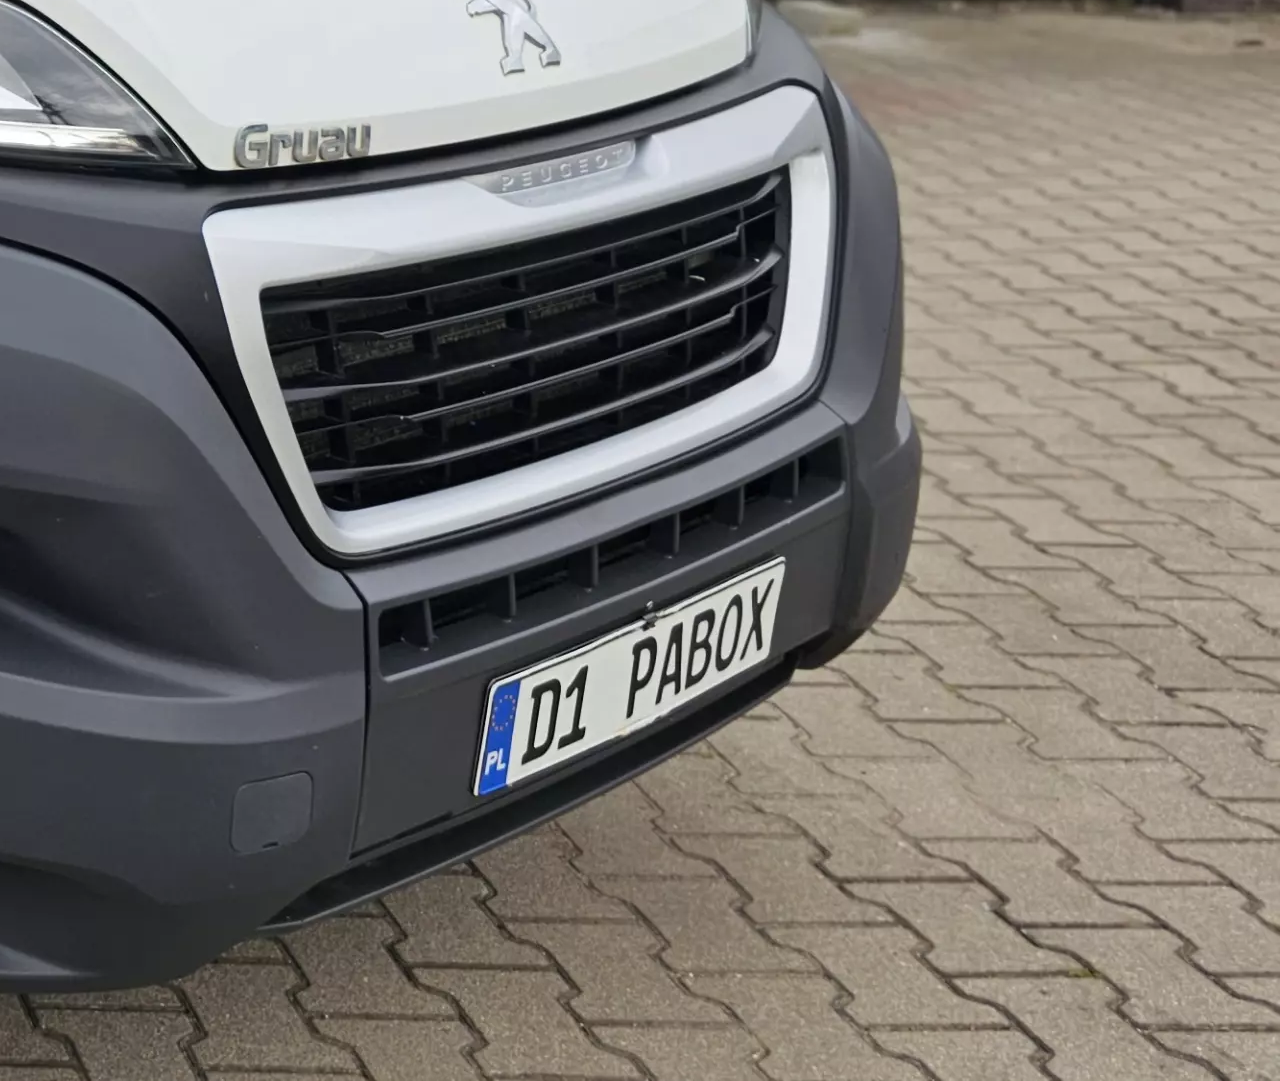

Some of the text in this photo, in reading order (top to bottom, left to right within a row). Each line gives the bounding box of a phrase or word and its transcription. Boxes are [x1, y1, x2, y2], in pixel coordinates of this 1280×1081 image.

[233, 123, 372, 169] Gruau
[500, 147, 624, 192] PEUGEOT
[520, 577, 775, 766] D1 PABOX
[483, 750, 507, 776] PL
